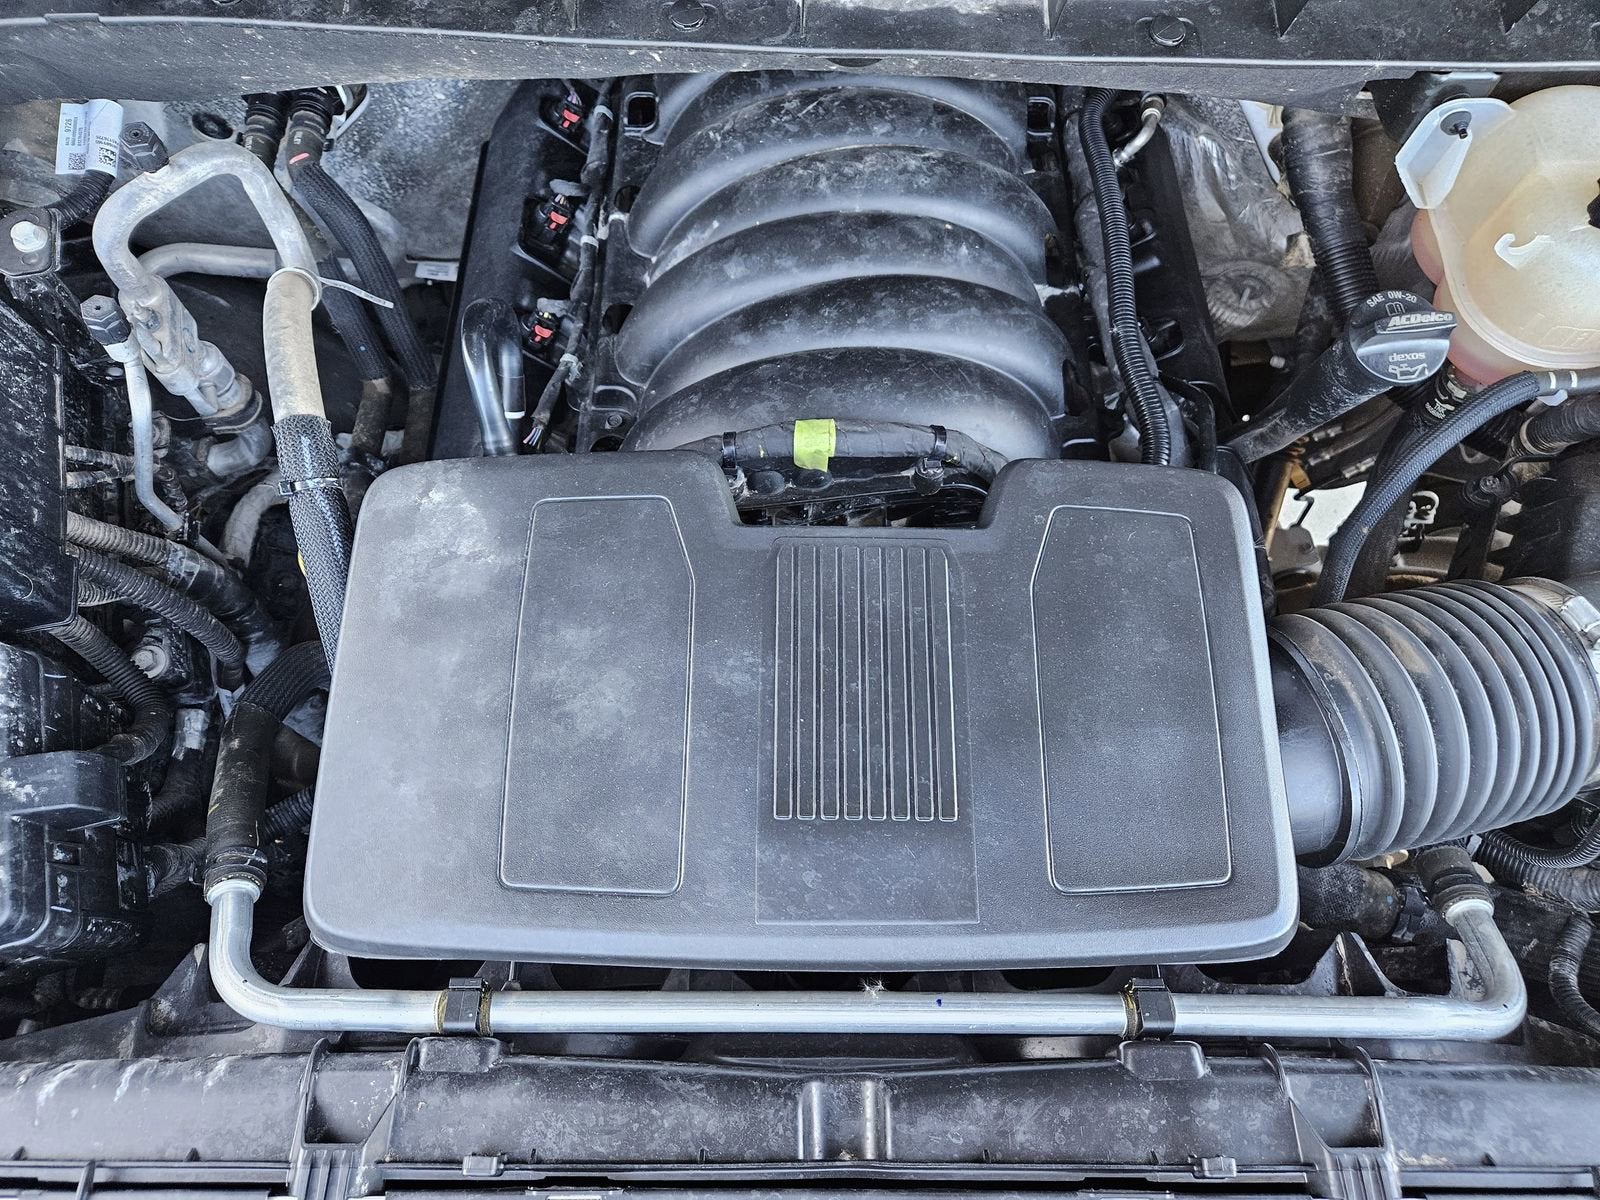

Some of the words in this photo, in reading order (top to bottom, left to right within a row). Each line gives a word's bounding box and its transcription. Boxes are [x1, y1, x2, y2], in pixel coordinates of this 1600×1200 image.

[1366, 293, 1385, 308] SAE
[1387, 291, 1418, 303] 0W-20
[1388, 312, 1453, 327] ACDelco
[1388, 352, 1426, 362] dexos
